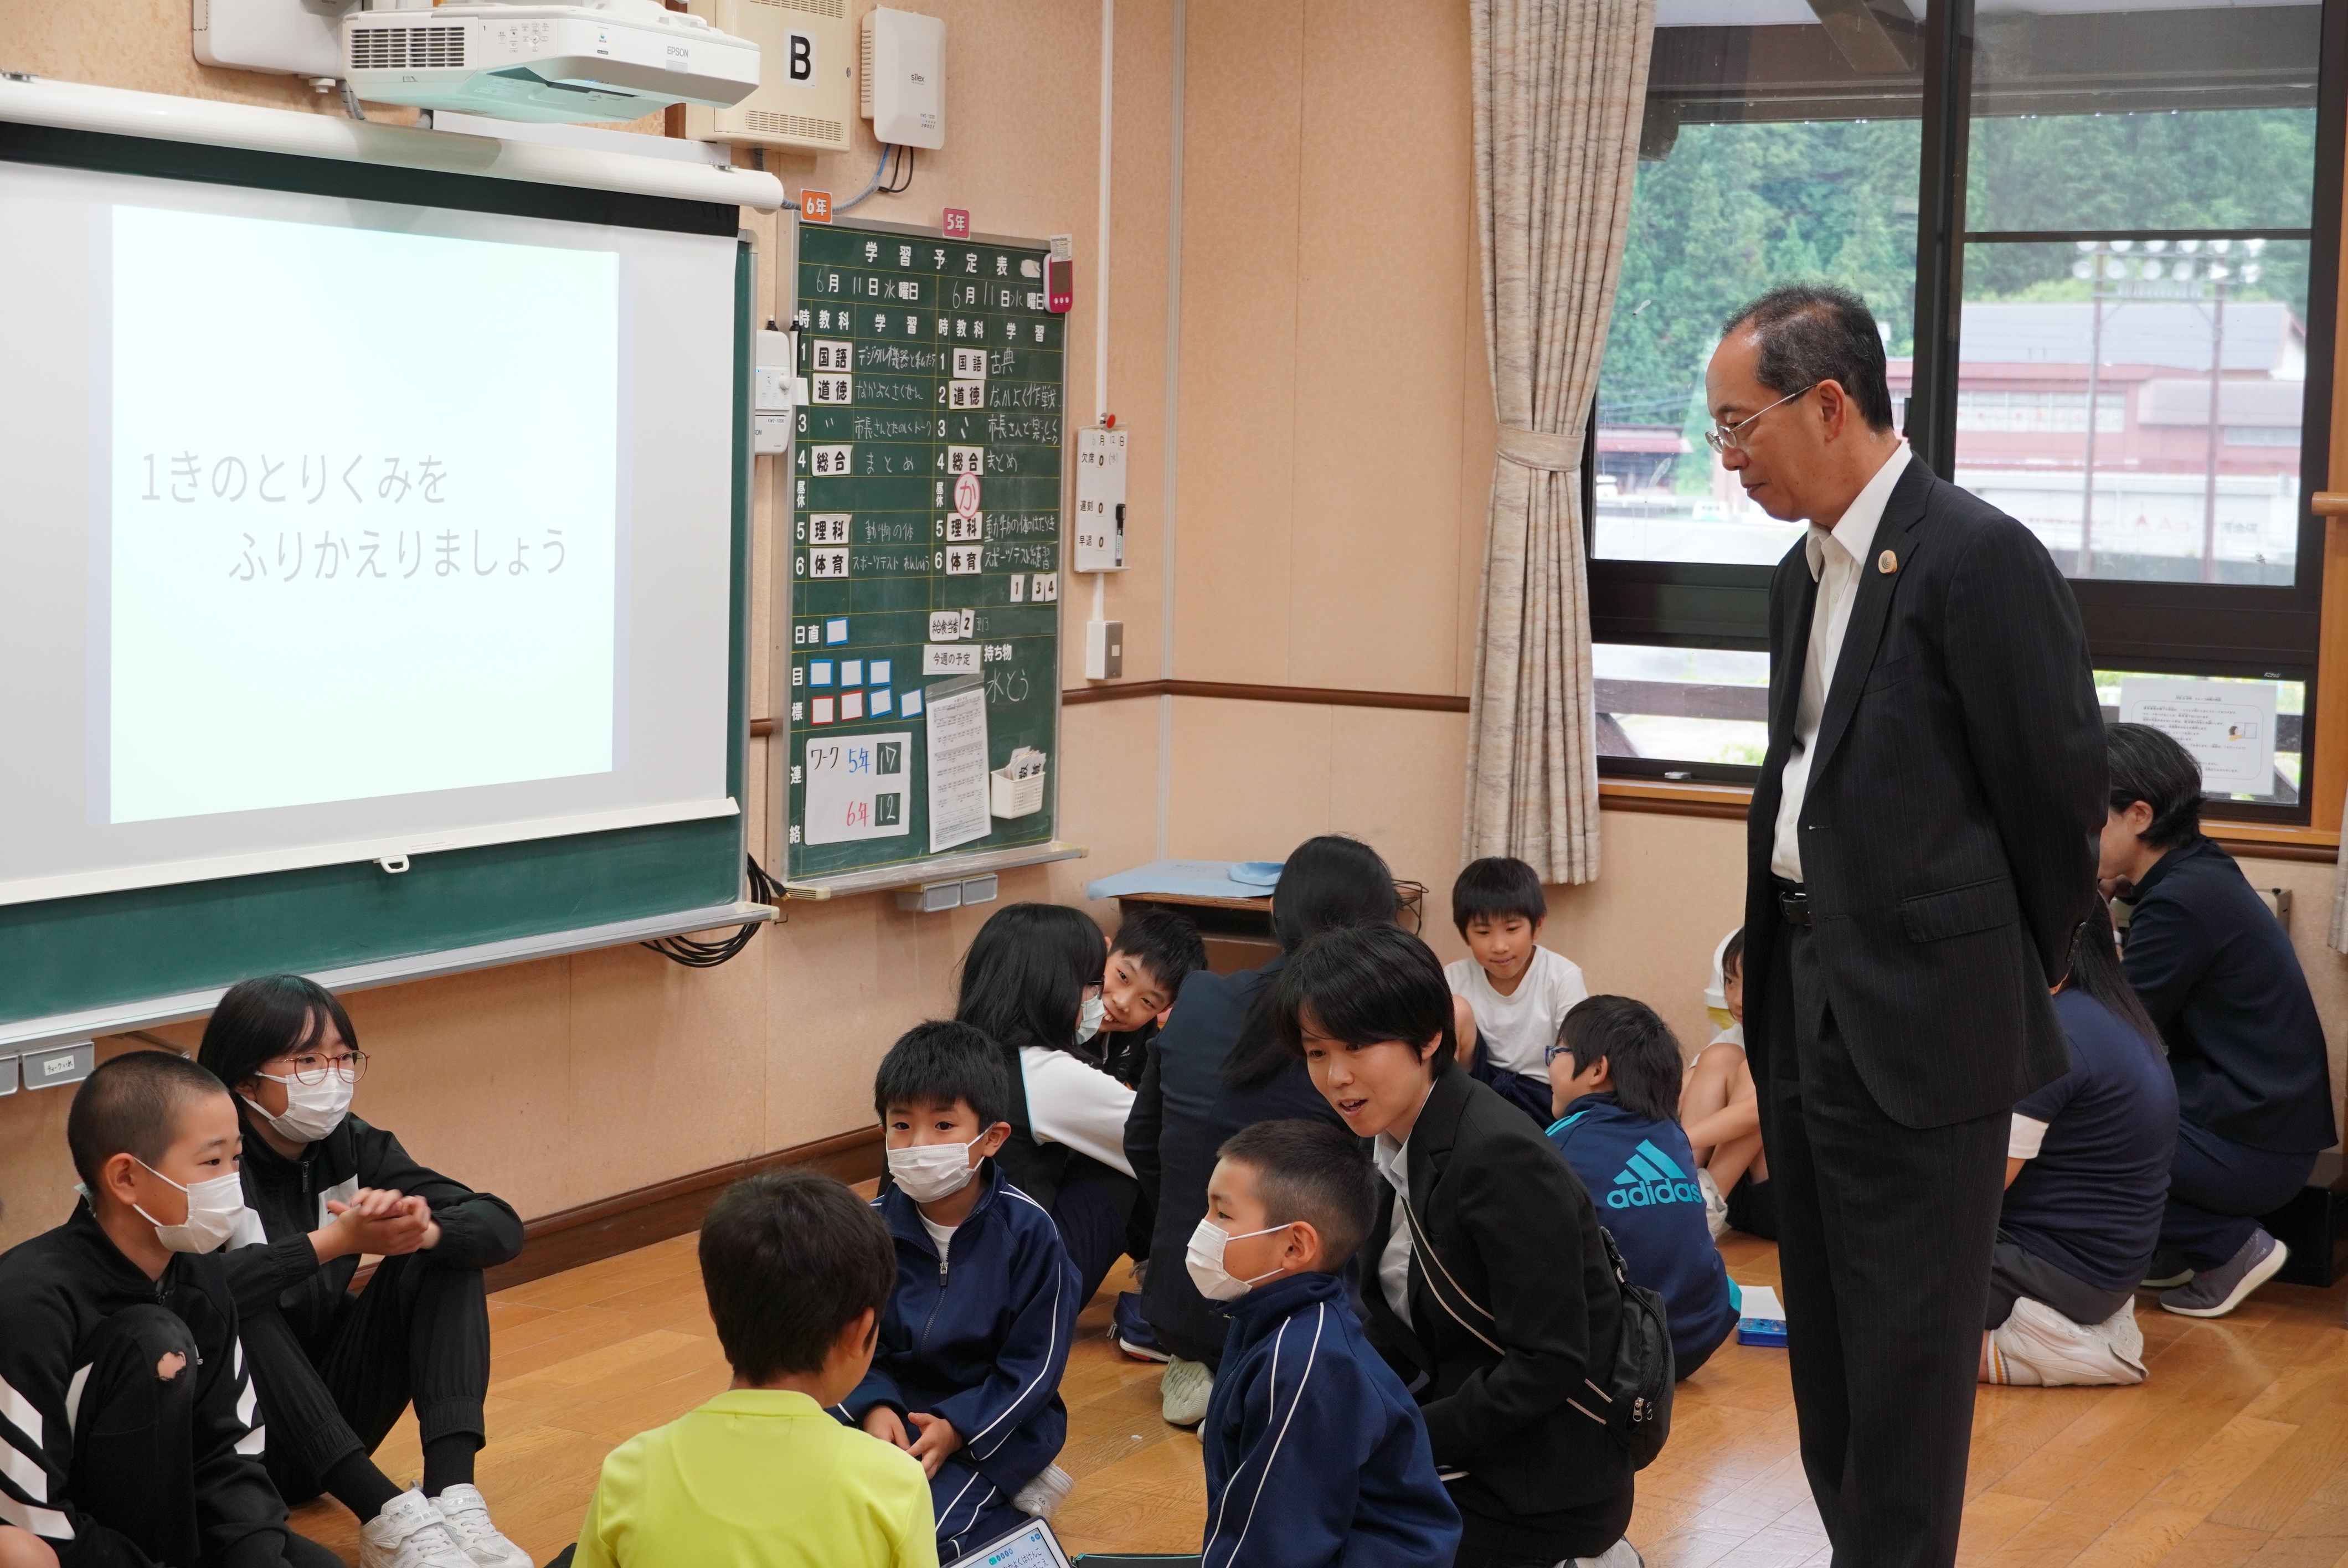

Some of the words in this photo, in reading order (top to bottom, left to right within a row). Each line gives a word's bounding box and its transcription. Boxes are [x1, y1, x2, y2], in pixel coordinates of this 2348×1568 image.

[667, 46, 689, 58] EPSON
[790, 35, 811, 81] B
[911, 73, 925, 82] silex
[806, 197, 827, 216] 6年
[947, 213, 966, 232] 5年
[866, 241, 1008, 276] 学習予定表
[799, 310, 810, 328] 時
[819, 310, 850, 331] 教科
[875, 314, 917, 334] 学習
[939, 318, 949, 336] 時
[956, 318, 984, 338] 教科
[1006, 322, 1044, 342] 学習
[801, 343, 806, 360] 1
[818, 348, 848, 368] 国語
[990, 347, 1016, 375] 古典
[940, 353, 945, 370] 1
[959, 355, 982, 372] 国語
[817, 380, 847, 401] 道徳
[939, 386, 946, 403] 2
[954, 387, 980, 406] 道徳
[799, 414, 807, 432] 3
[938, 420, 945, 437] 3
[797, 450, 806, 467] 4
[817, 451, 846, 472] 総合
[866, 452, 914, 475] まとめ
[936, 453, 945, 470] 4
[952, 452, 977, 472] 総合
[987, 450, 1017, 472] まとめ
[1082, 452, 1095, 464] 欠席
[141, 450, 447, 504] 1きのとりくみを
[796, 481, 805, 508] 昼休
[936, 482, 944, 508] 昼休
[959, 480, 976, 510] か
[1080, 500, 1093, 512] 遅刻
[796, 522, 805, 540] 5
[815, 521, 844, 541] 理科
[936, 520, 943, 537] 5
[951, 518, 977, 538] 理科
[1079, 535, 1092, 546] 早退
[228, 527, 565, 583] ふりかえりましょう
[815, 554, 843, 575] 体育
[934, 551, 943, 569] 6
[951, 551, 976, 571] 体育
[796, 557, 805, 575] 6
[1015, 582, 1019, 594] 1
[1036, 581, 1042, 594] 3
[1048, 581, 1054, 594] 4
[795, 625, 820, 644] 日直
[932, 617, 959, 635] 給食当番
[964, 617, 970, 630] 2
[933, 652, 971, 666] 今週の予定
[984, 643, 1012, 662] 持ち物
[985, 667, 1029, 703] 水とう
[811, 746, 840, 770] ワーク
[848, 747, 871, 773] 5年
[846, 802, 870, 827] 6年
[879, 795, 896, 822] 12
[48, 1060, 73, 1074] チョークいれ
[1606, 1178, 1702, 1209] adidas
